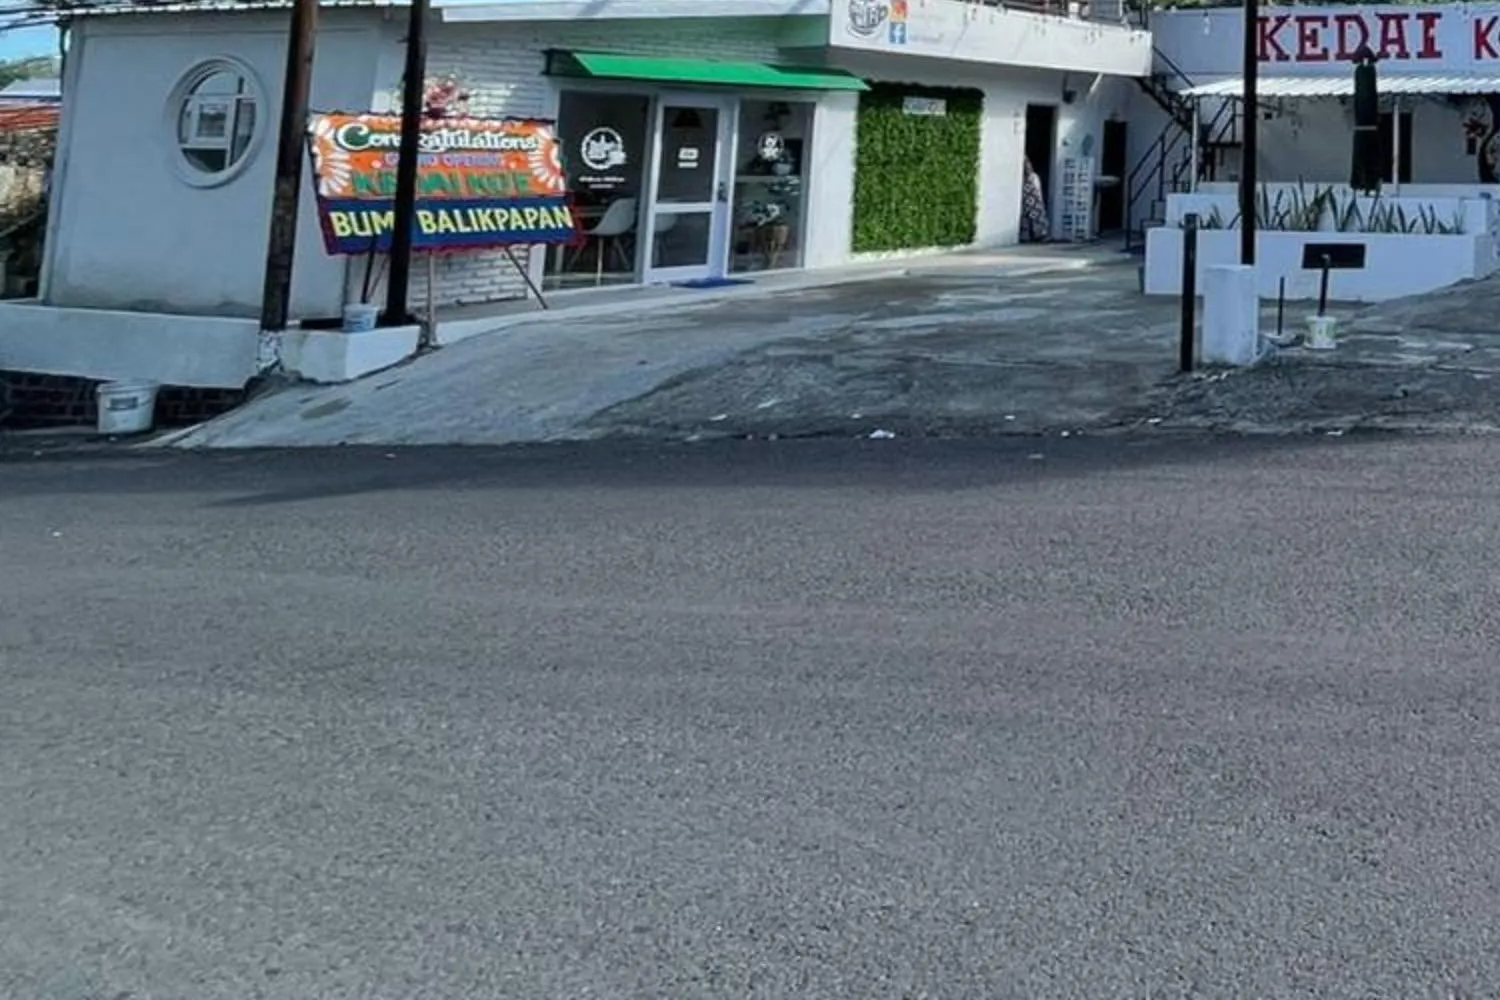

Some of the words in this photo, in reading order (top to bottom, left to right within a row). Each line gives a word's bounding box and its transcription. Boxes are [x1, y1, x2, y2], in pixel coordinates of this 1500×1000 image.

[1256, 12, 1443, 62] KEDAI
[329, 210, 396, 238] BUM
[415, 205, 575, 235] BALIKPAPAN
